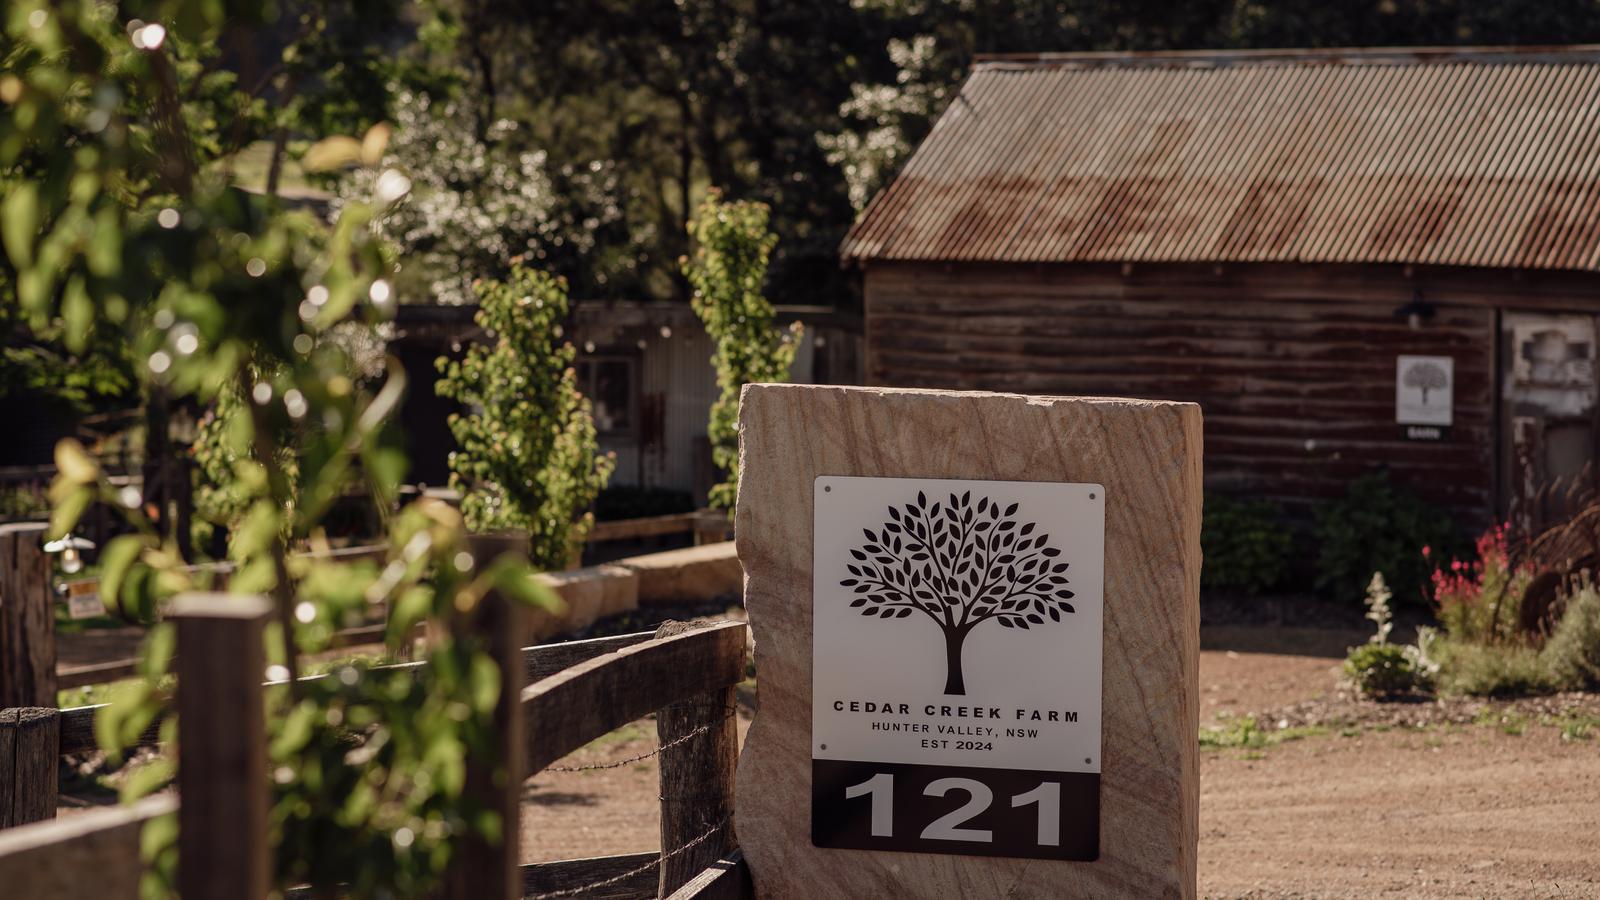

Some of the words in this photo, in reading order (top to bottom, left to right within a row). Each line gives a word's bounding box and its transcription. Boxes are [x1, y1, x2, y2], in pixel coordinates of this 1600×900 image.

[833, 701, 909, 715] CEDAR
[924, 704, 1001, 719] CREEK
[1016, 709, 1078, 722] FARM
[872, 722, 929, 733] HUNTER
[937, 725, 998, 738] VALLEY,
[1006, 728, 1039, 738] NSW
[921, 739, 949, 749] EST
[956, 741, 993, 751] 2024
[845, 773, 1061, 846] 121
